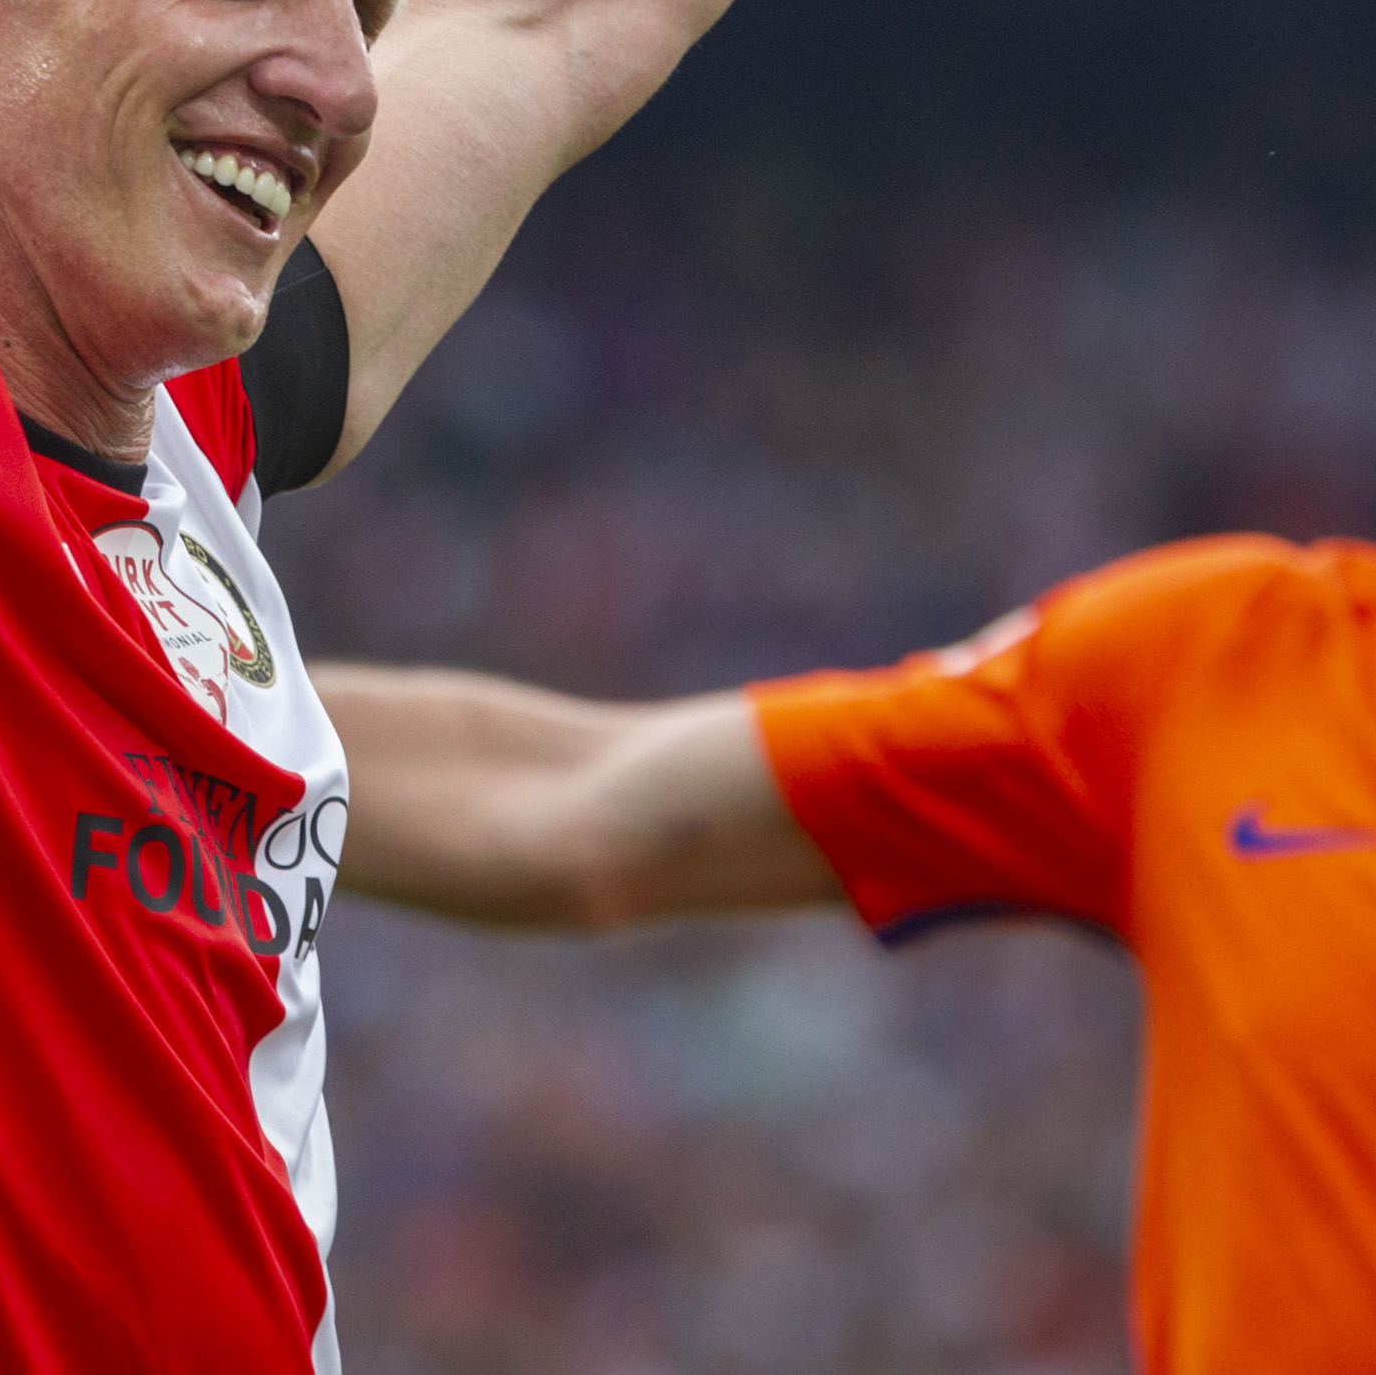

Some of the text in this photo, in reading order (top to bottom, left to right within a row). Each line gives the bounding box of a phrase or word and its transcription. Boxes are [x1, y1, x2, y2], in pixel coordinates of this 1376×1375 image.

[101, 553, 164, 596] IRK
[140, 599, 189, 631] YT
[159, 631, 212, 650] MONIAL
[70, 811, 325, 960] FOUDA
